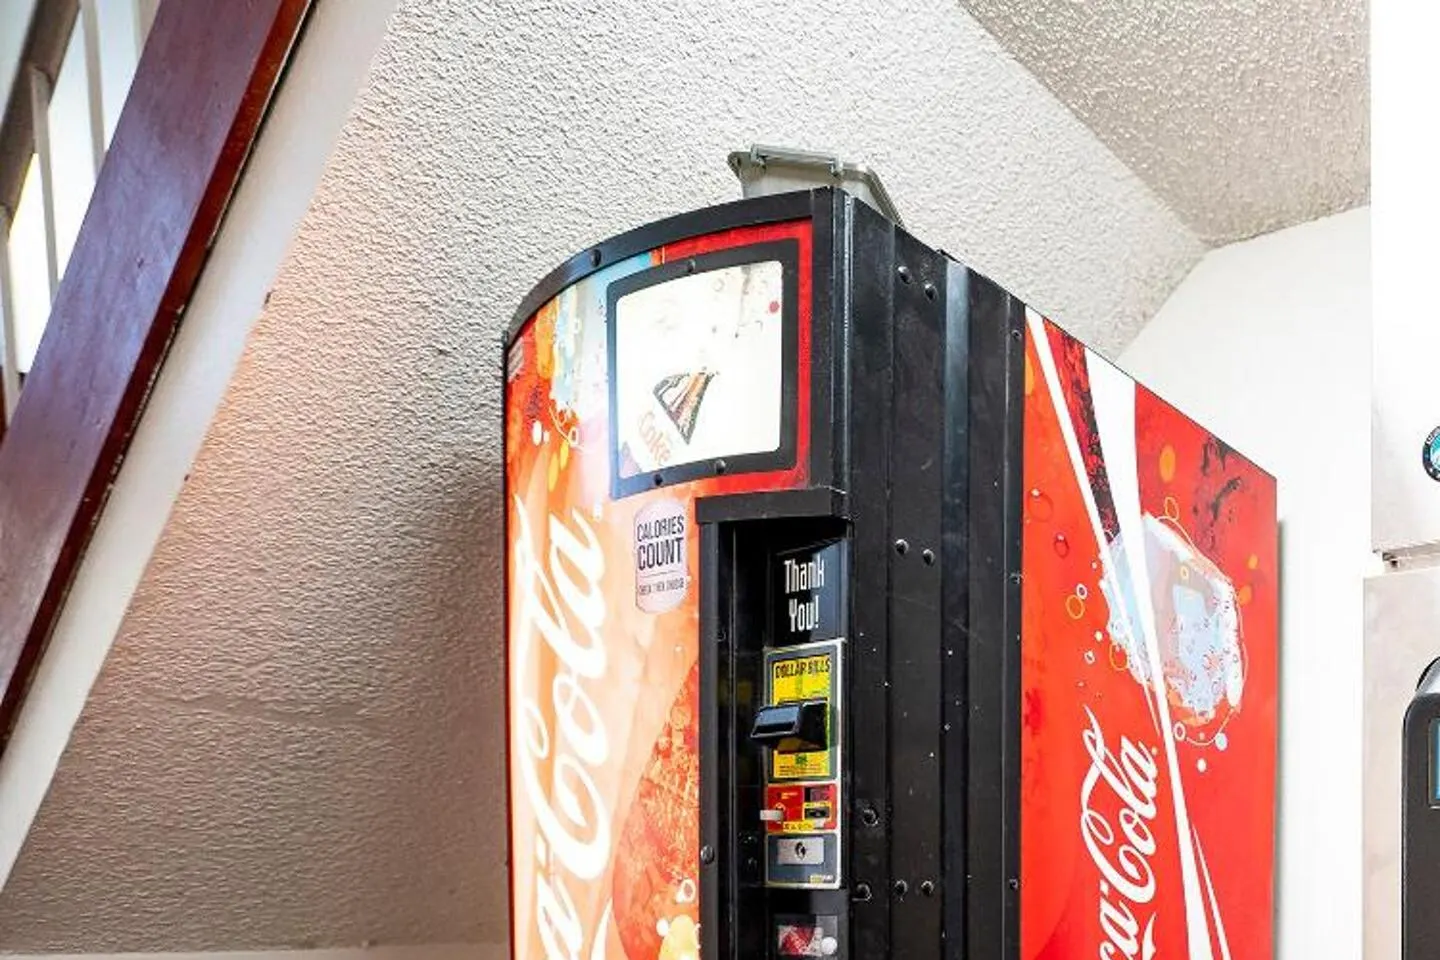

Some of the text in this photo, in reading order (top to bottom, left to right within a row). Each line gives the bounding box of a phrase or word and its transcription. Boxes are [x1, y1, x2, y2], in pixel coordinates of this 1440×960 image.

[637, 514, 685, 543] CALORIES
[637, 536, 685, 571] COUNT
[783, 553, 825, 595] Thank
[788, 595, 820, 633] You!
[775, 661, 807, 679] DOLLAR
